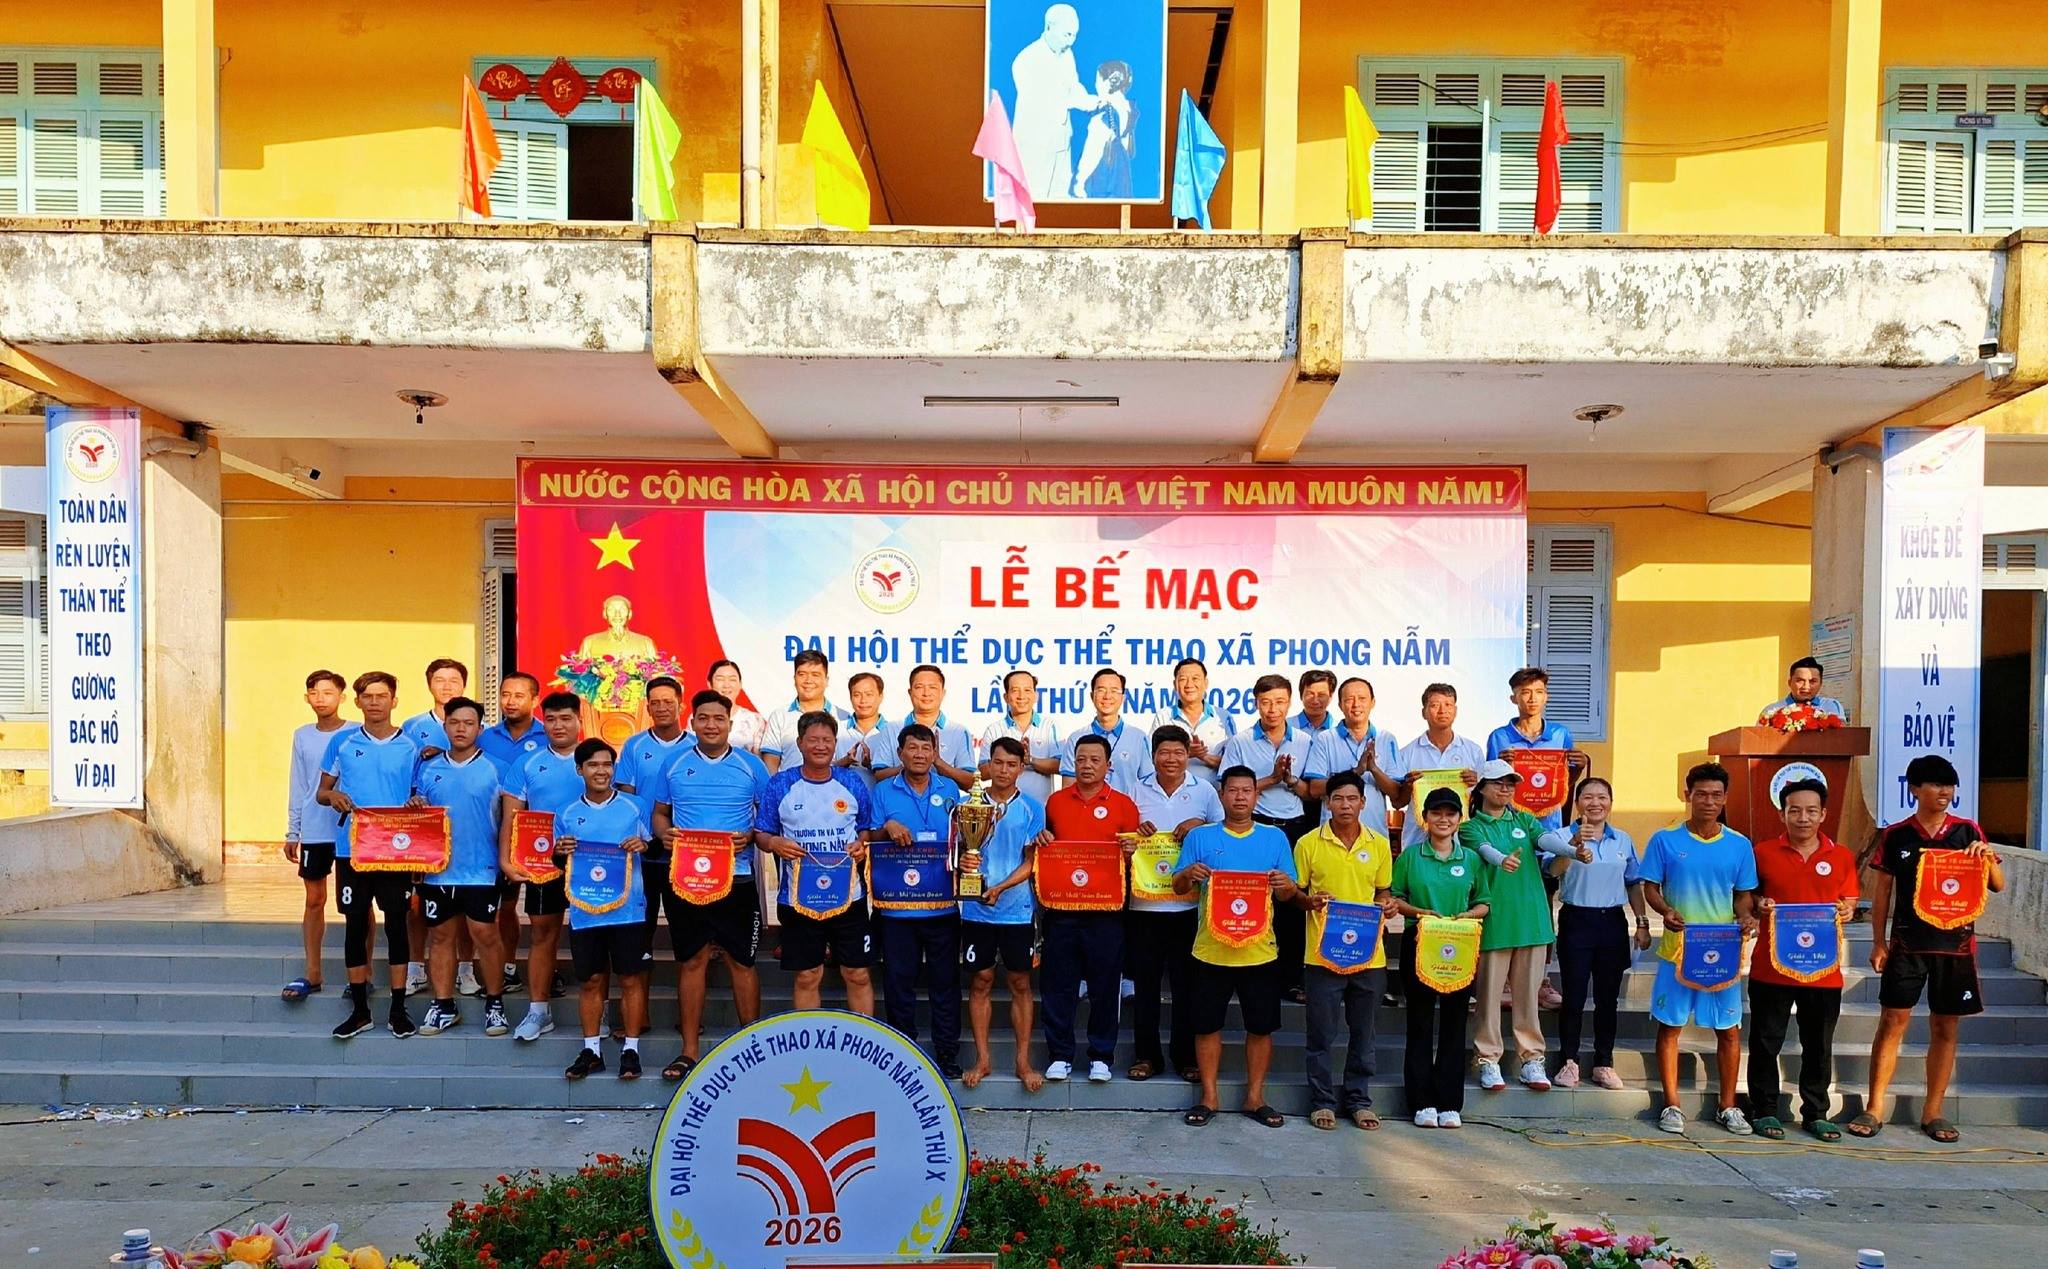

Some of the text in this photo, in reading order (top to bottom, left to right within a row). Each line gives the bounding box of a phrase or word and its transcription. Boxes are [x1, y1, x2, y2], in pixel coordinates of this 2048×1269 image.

[539, 468, 1504, 510] NƯỚC CỘNG HÒA XÃ HỘI CHỦ NGHĨA VIỆT NAM MUÔN NĂM!
[59, 494, 127, 524] TOÀN DÂN
[1900, 512, 1939, 558] KHỎE
[56, 537, 131, 573] RÈN LUYỆN
[60, 575, 128, 613] THÂN THỂ
[970, 545, 1030, 608] LỄ
[1055, 550, 1129, 609] BẾ
[1145, 567, 1259, 619] MẠC
[1895, 577, 1968, 628] XÂY DỰNG
[76, 632, 112, 657] THEO
[848, 629, 899, 669] HỘI
[910, 624, 971, 664] THỂ
[983, 637, 1044, 670] DỤC
[1054, 624, 1115, 665] THỂ
[1126, 637, 1206, 665] THAO
[1217, 632, 1256, 665] XÃ
[1269, 638, 1371, 666] PHONG
[1382, 625, 1451, 666] NẪM
[1921, 644, 1940, 686] VÀ
[71, 674, 116, 701] GƯƠNG
[971, 675, 1010, 713] LẦ
[1036, 680, 1088, 714] THỨ
[1203, 688, 1258, 714] 026
[69, 710, 119, 745] BÁC HỒ
[1903, 701, 1955, 755] BẢO VỆ
[75, 758, 116, 793] VĨ ĐẠI
[342, 886, 352, 904] 8
[425, 899, 438, 918] 12
[863, 934, 871, 953] 2
[966, 944, 976, 962] 6
[731, 1033, 767, 1073] THỂ
[766, 1029, 811, 1056] THAO
[814, 1025, 838, 1050] XÃ
[840, 1032, 895, 1071] PHONG
[701, 1064, 737, 1101] DỤC
[680, 1090, 713, 1130] THỂ
[912, 1094, 946, 1131] LẦN
[670, 1132, 700, 1161] HỘI
[924, 1131, 953, 1164] THỨ
[670, 1167, 697, 1197] ĐẠI
[925, 1169, 947, 1182] X
[764, 1215, 842, 1247] 2026
